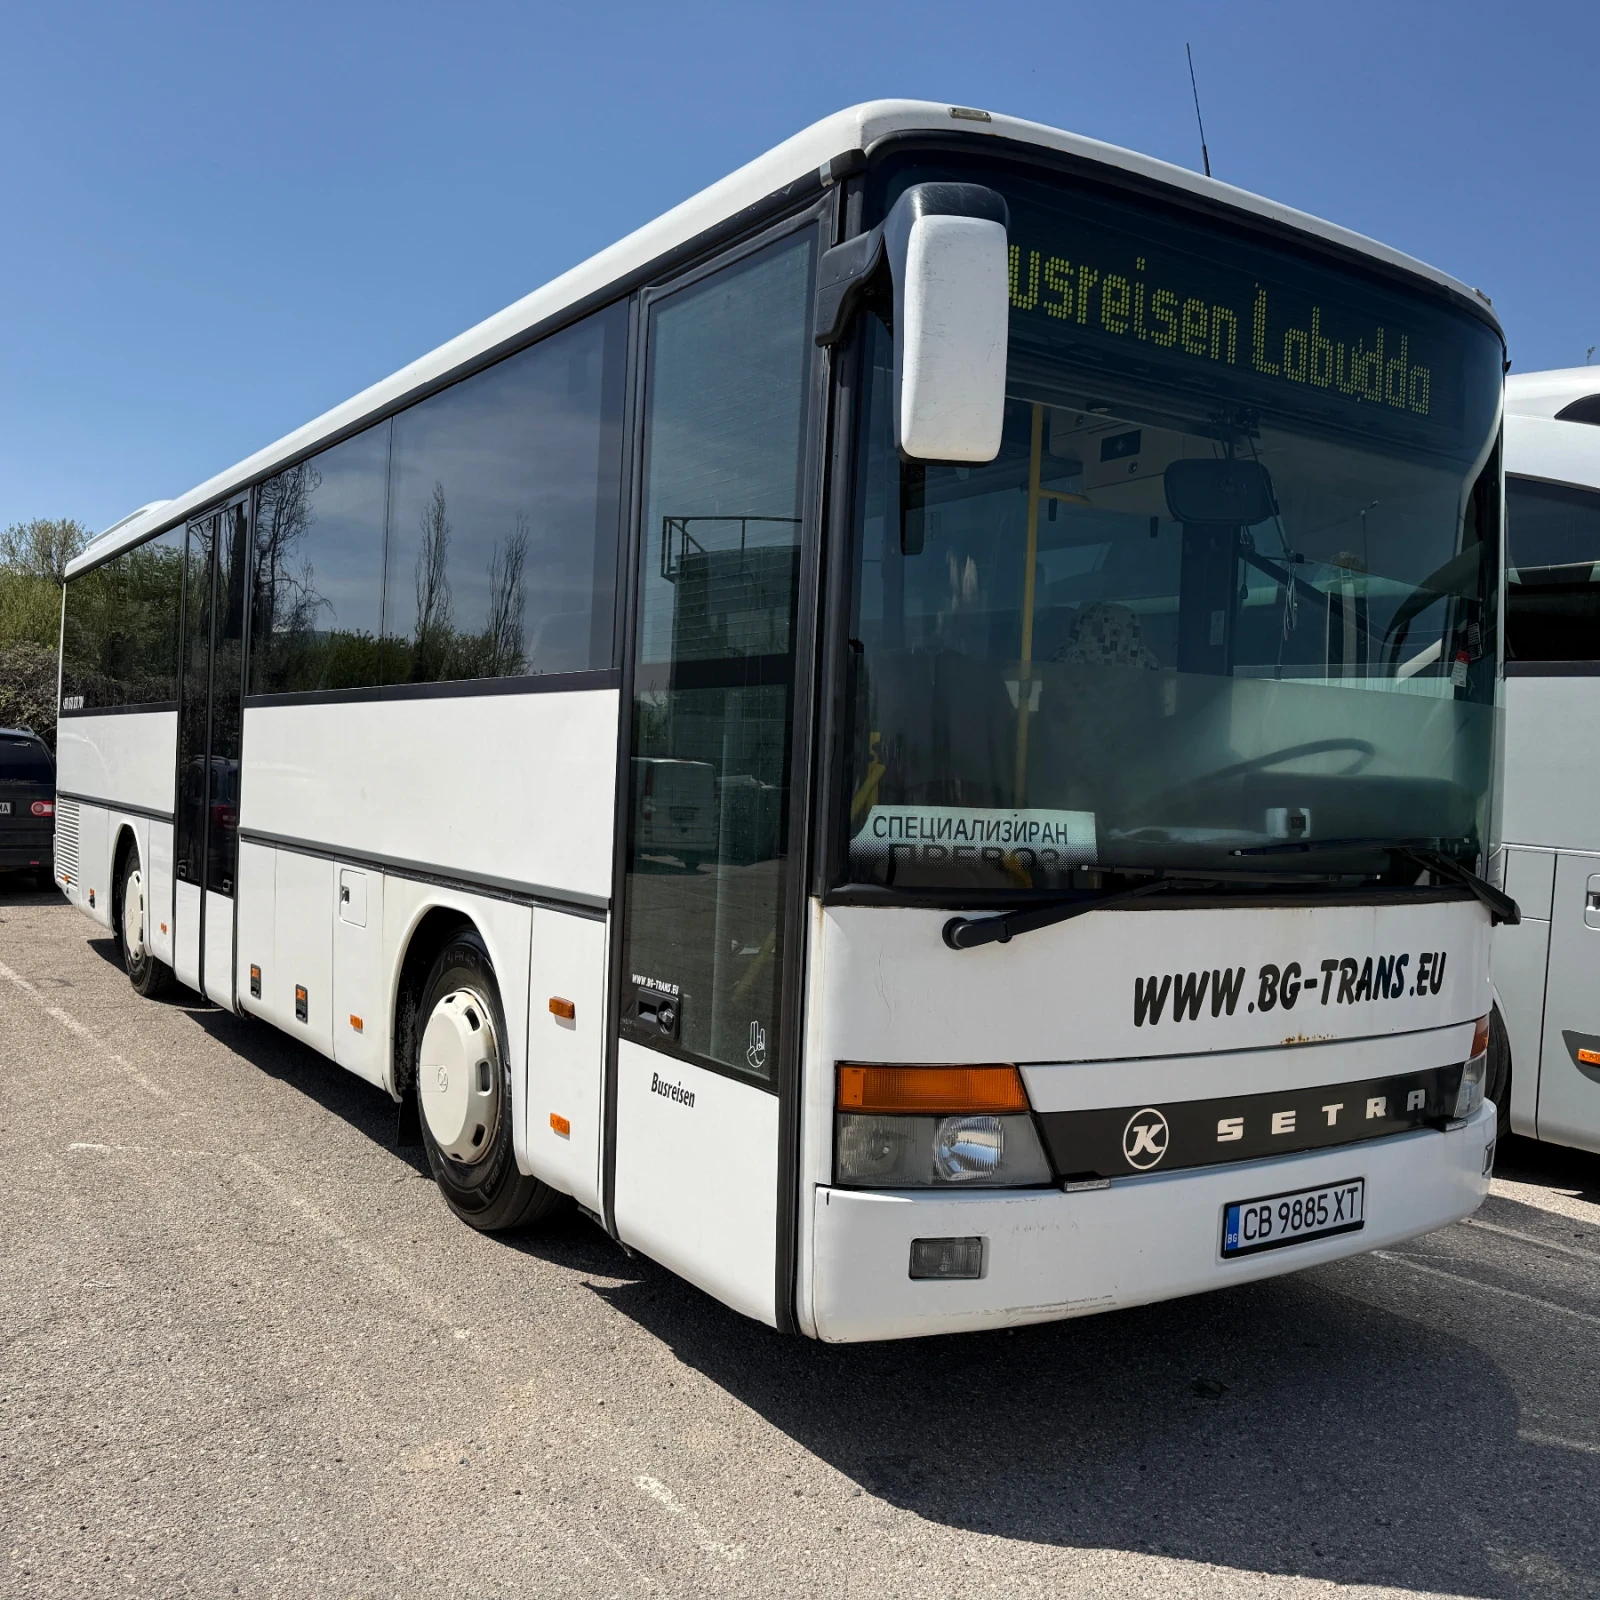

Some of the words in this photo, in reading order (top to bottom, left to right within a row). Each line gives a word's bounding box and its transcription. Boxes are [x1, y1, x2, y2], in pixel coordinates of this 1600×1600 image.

[1008, 244, 1238, 365] usreisen
[872, 815, 1069, 845] СПЕЦИАЛИЗИРАН
[631, 973, 680, 995] WWW.BG-TRANS.EU
[1133, 951, 1447, 1028] WWW.BG-TRANS.EU
[650, 1071, 696, 1109] Busreisen
[1216, 1088, 1427, 1143] SETRA
[1278, 1193, 1329, 1234] 9885
[1227, 1233, 1238, 1244] BG
